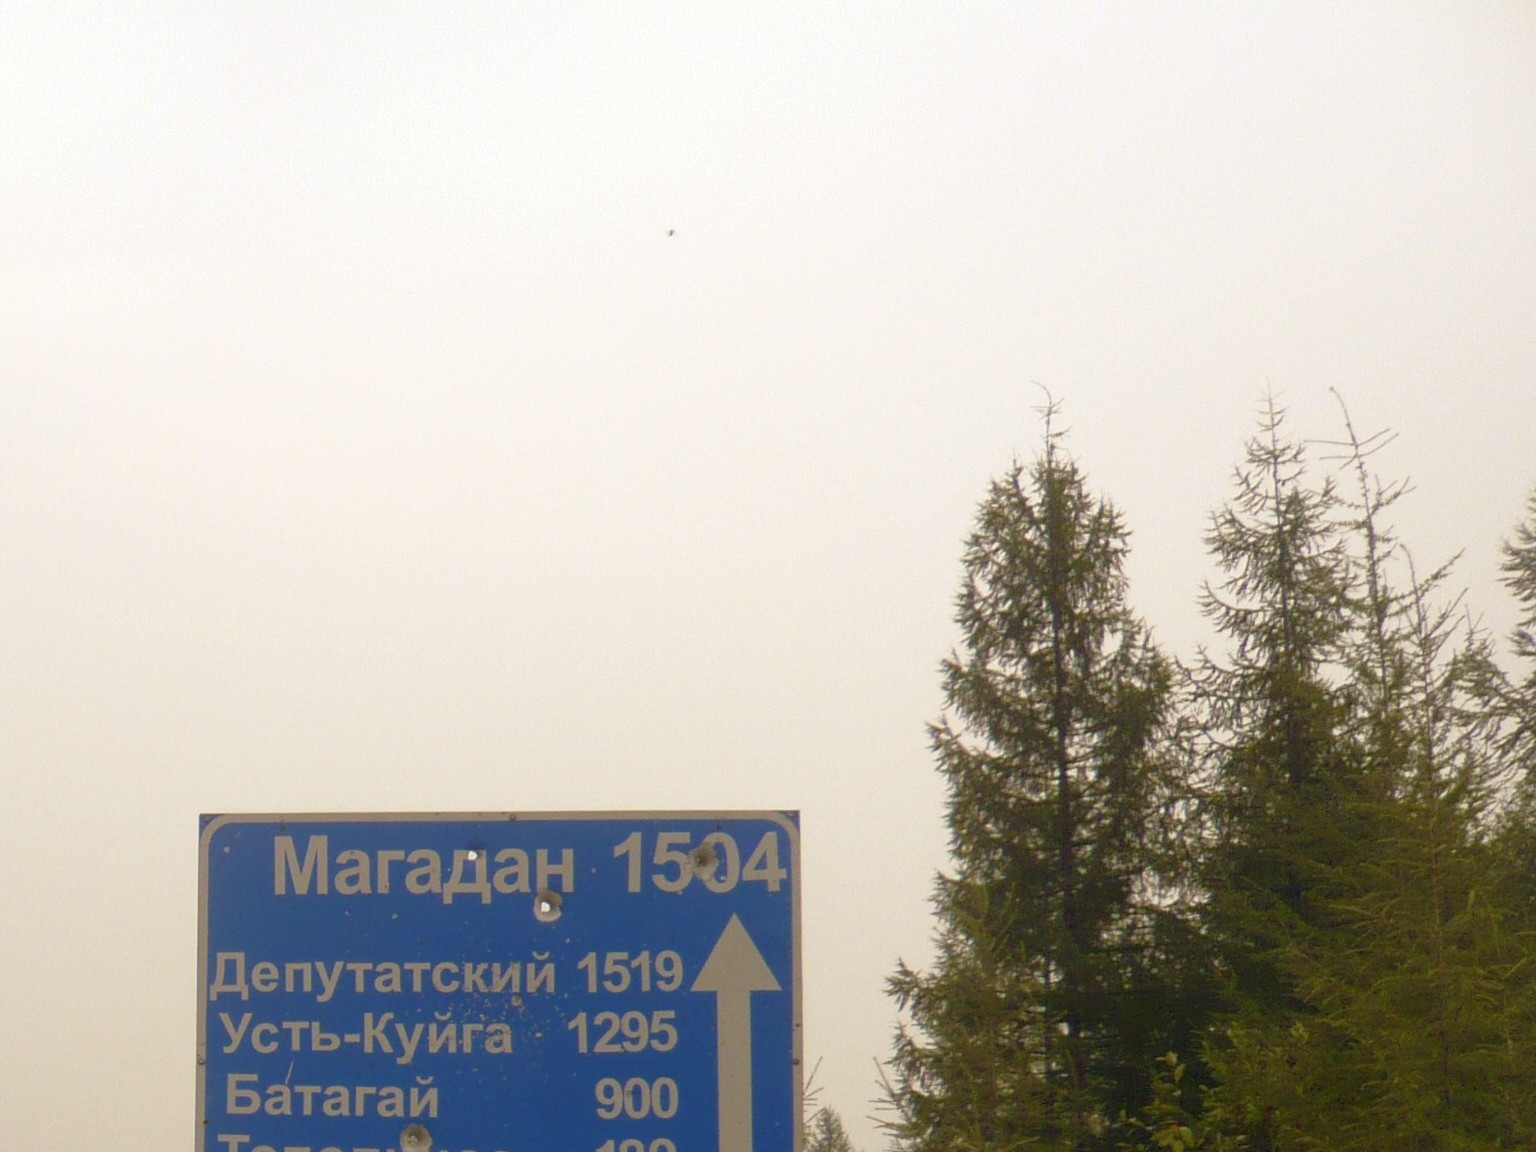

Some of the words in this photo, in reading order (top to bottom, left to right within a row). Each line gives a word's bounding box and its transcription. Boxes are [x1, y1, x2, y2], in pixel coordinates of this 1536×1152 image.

[273, 834, 574, 904] Магадан
[613, 831, 787, 894] 1504
[209, 951, 556, 1001] Депутатский
[576, 949, 684, 994] 1519
[219, 1011, 513, 1064] Усть-Куйга
[566, 1010, 678, 1054] 1295
[226, 1073, 439, 1118] Батагай
[595, 1077, 679, 1120] 900
